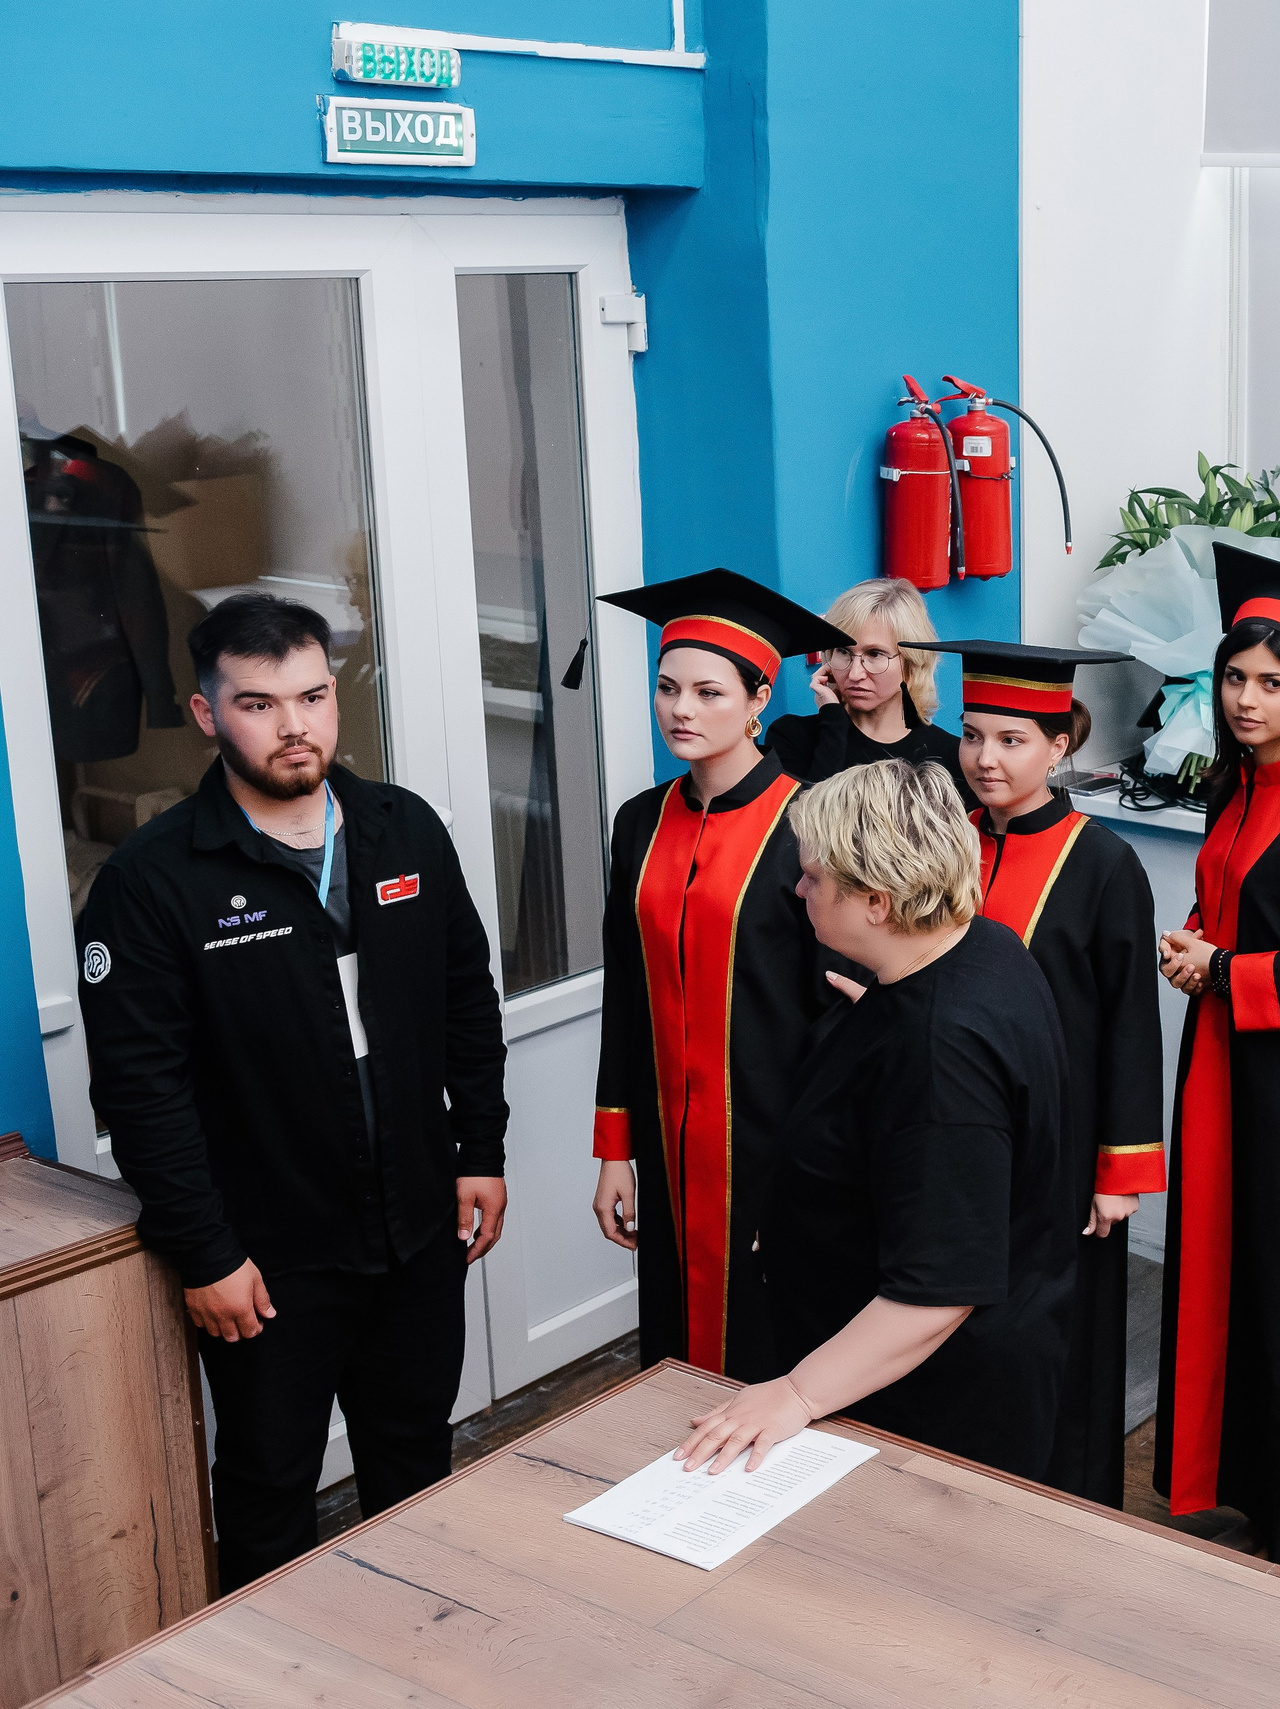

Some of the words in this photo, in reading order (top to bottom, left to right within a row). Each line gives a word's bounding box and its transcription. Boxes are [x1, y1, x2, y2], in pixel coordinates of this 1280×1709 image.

[361, 43, 452, 87] ВЫХОД
[341, 109, 459, 147] ВЫХОД
[243, 910, 267, 924] MF
[204, 937, 239, 950] SENSE
[239, 933, 256, 944] OF
[255, 926, 293, 940] SPEED
